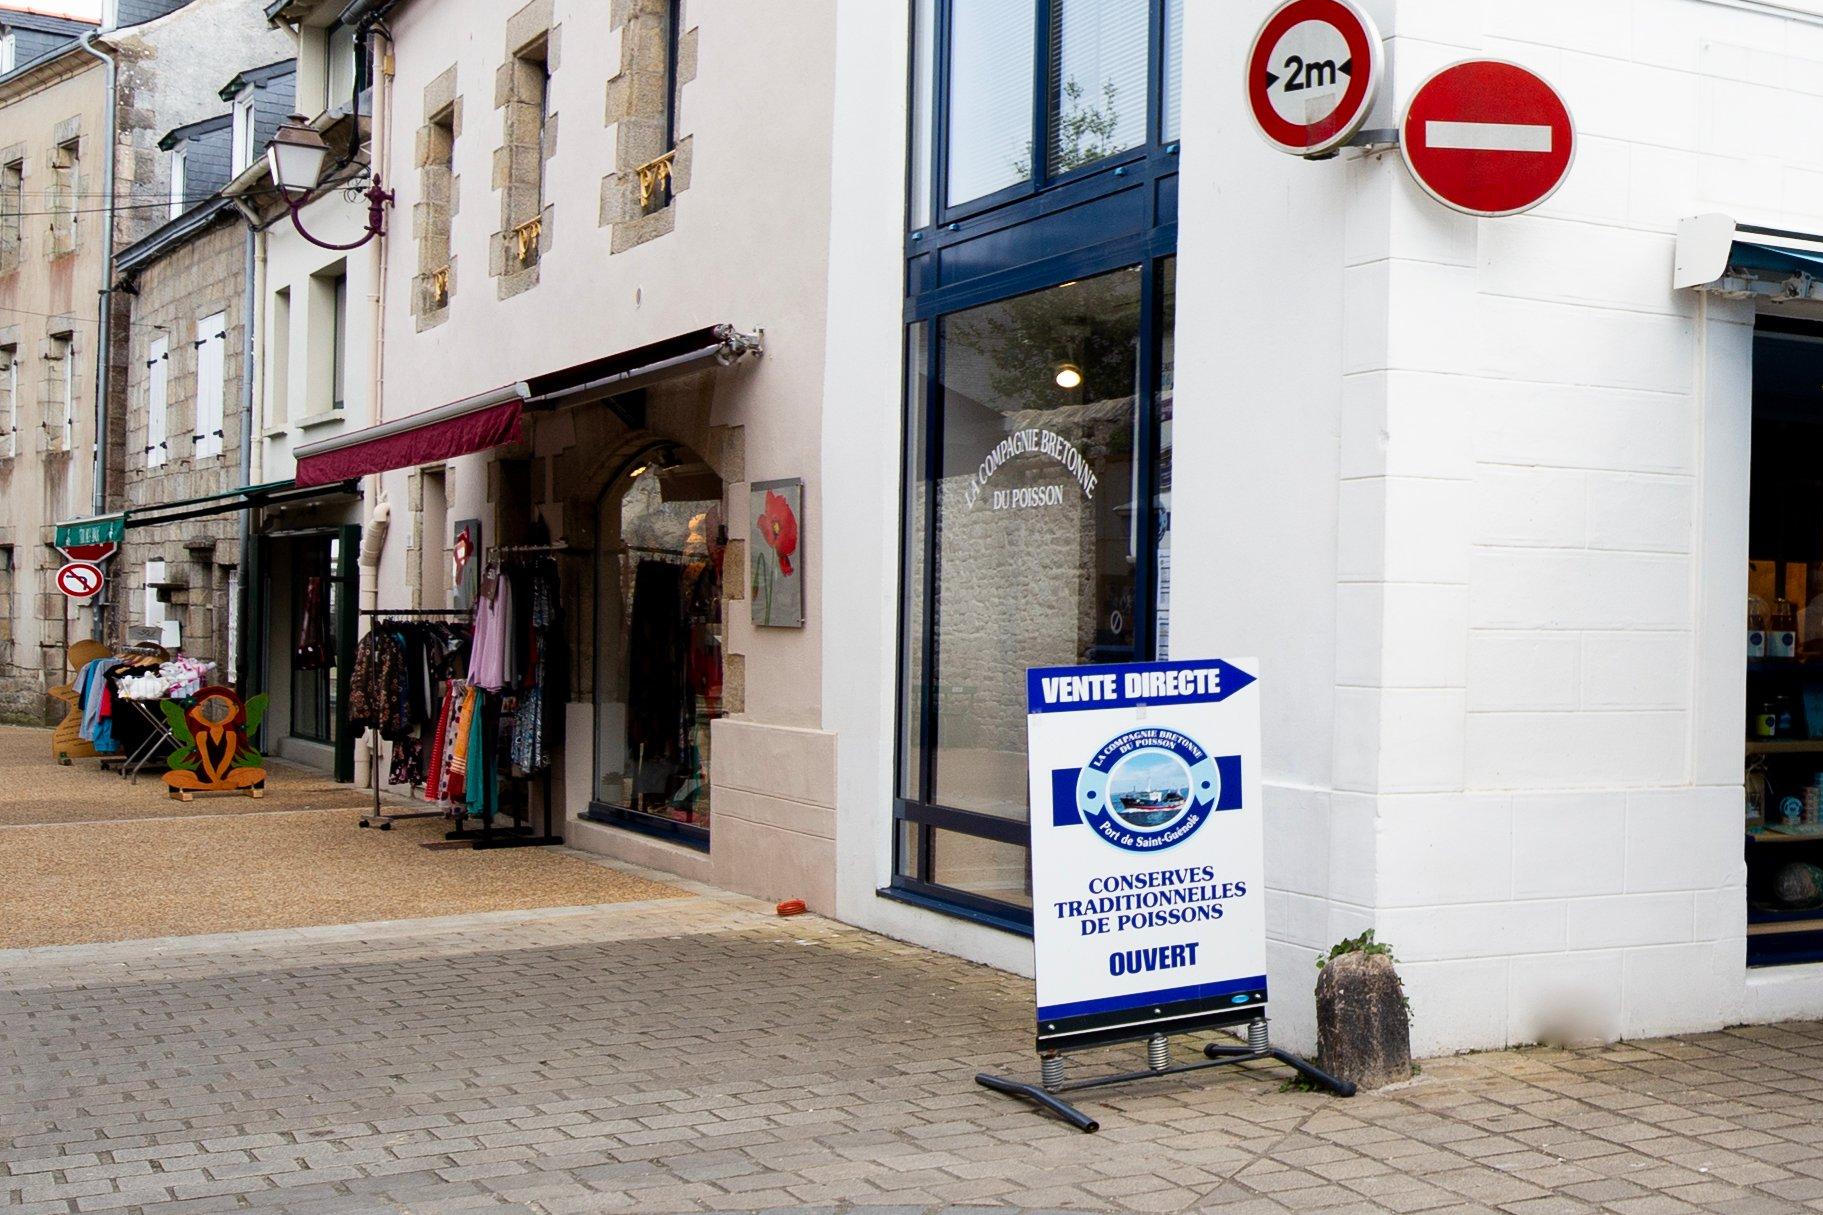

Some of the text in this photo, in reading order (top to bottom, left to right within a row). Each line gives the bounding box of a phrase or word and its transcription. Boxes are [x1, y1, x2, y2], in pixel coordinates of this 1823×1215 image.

[1284, 55, 1336, 93] 2m
[965, 429, 1098, 509] LA COMPAGNIE BRETONNE
[993, 485, 1064, 510] DU POISSON
[1041, 668, 1221, 704] VENTE DIRECTE
[1093, 730, 1203, 767] LA COMPAGNIE BRETONNE
[1119, 737, 1176, 754] DU POISSON
[1099, 814, 1200, 847] Port de Saint-Guénolé
[1088, 865, 1214, 894] CONSERVES
[1054, 881, 1246, 918] TRADITIONNELLES
[1081, 903, 1223, 936] DE POISSONS
[1109, 942, 1199, 976] OUVERT
